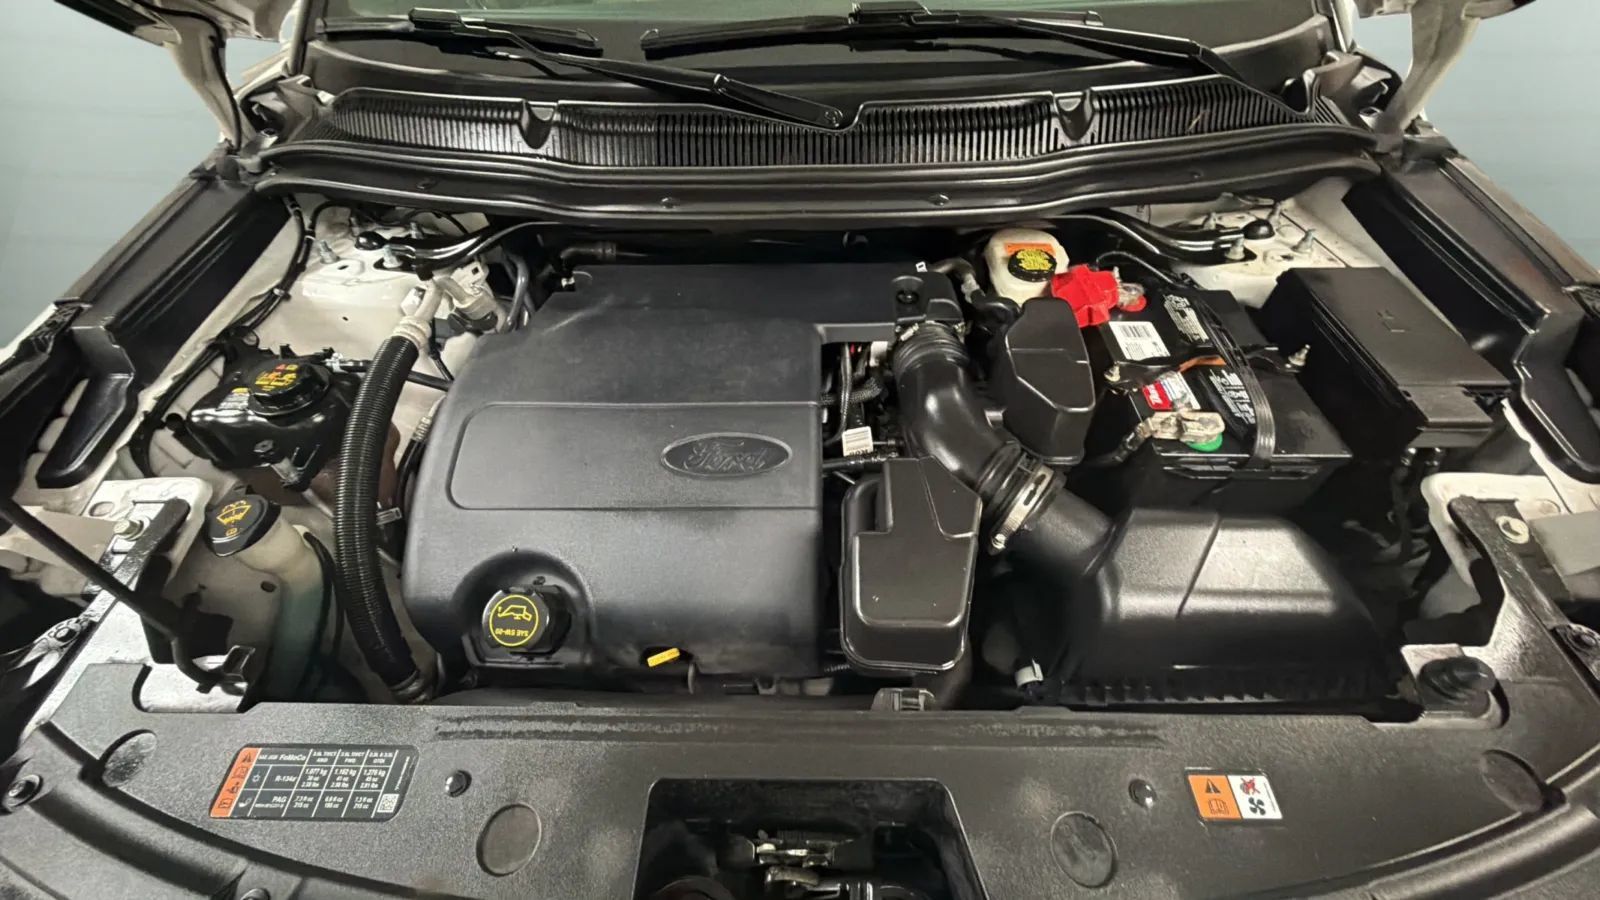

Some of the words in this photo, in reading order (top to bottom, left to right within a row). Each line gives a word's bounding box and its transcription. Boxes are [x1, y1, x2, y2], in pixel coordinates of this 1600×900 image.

[683, 442, 767, 471] Ford
[279, 753, 307, 761] FoMoCo
[320, 768, 328, 777] kg
[349, 769, 357, 777] kg
[378, 769, 386, 778] kg
[271, 795, 287, 803] PAG
